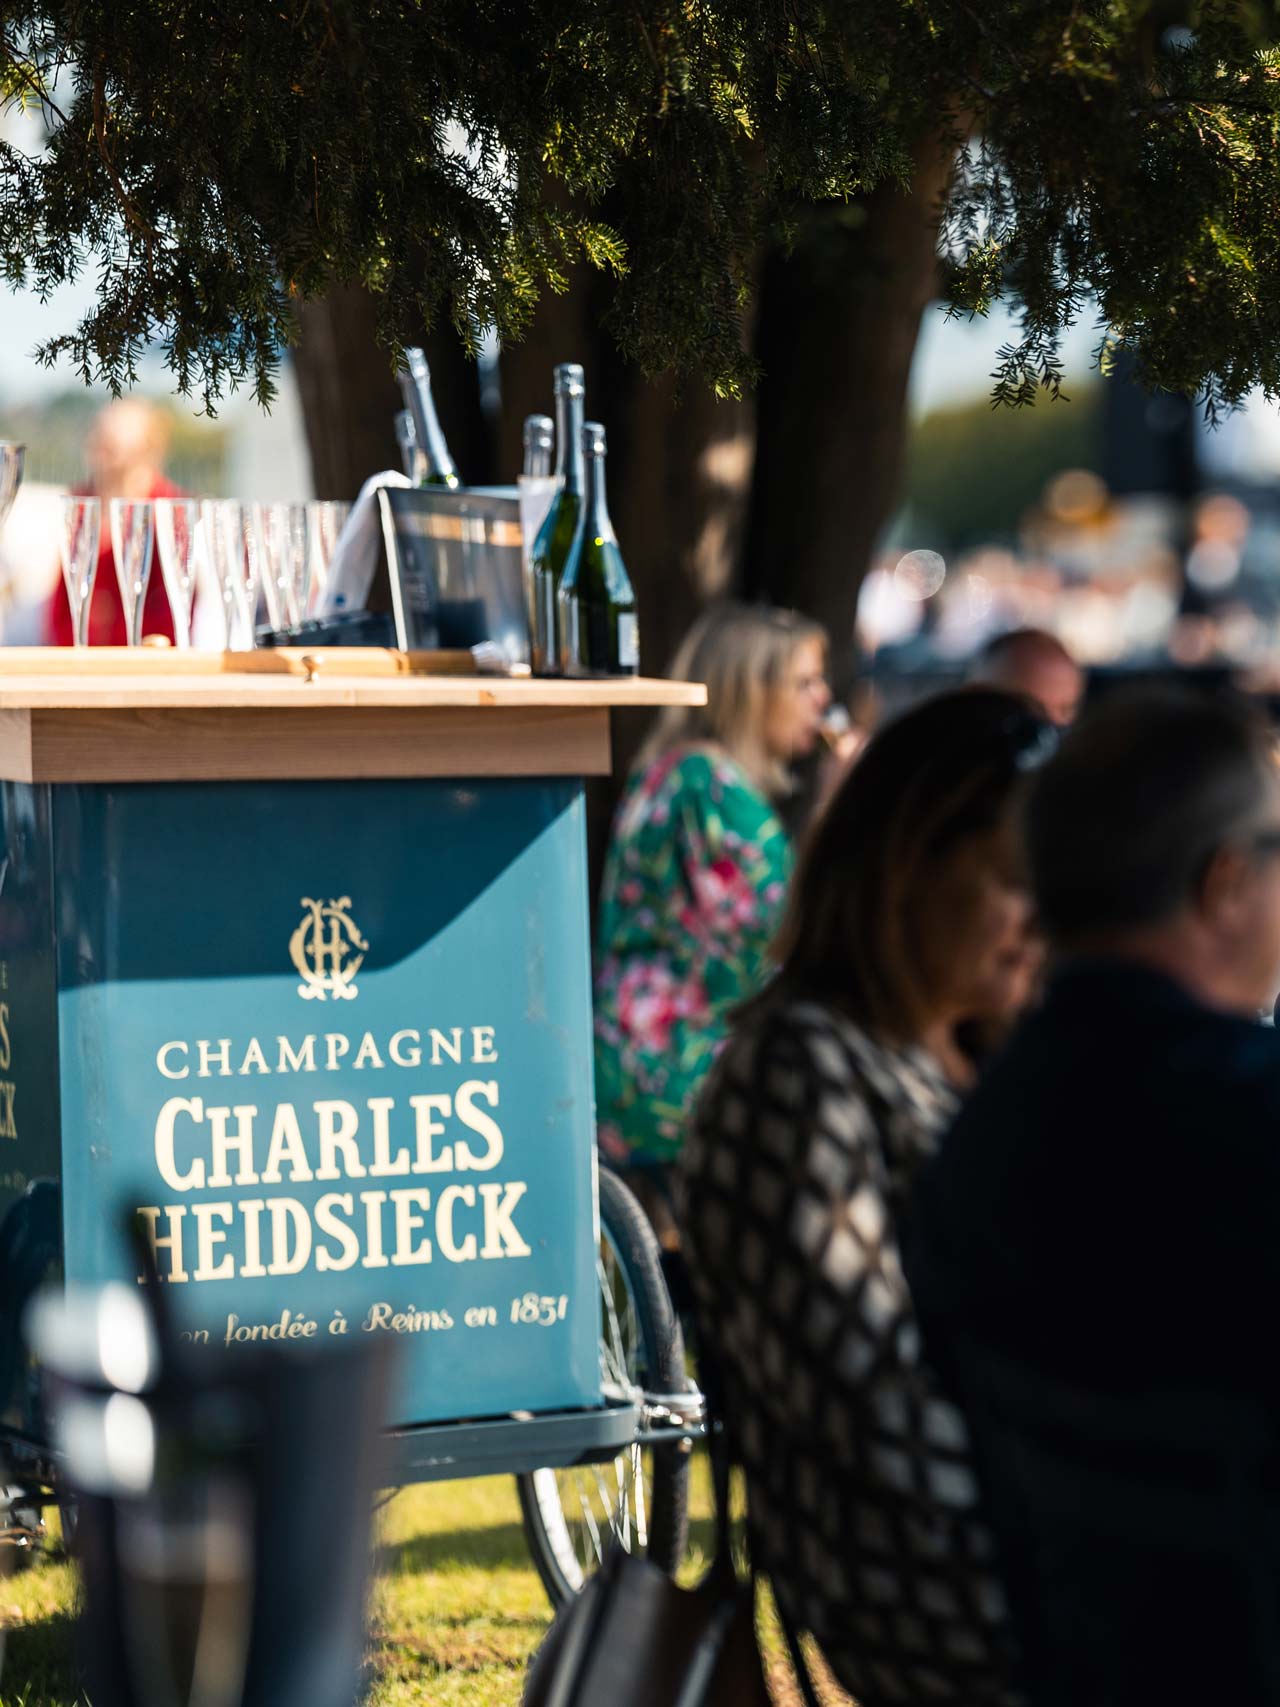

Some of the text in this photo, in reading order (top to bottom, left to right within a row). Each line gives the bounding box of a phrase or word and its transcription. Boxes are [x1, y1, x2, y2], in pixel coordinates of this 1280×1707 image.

[156, 1025, 499, 1080] CHAMPAGNE
[154, 1080, 503, 1191] CHARLES
[137, 1181, 531, 1284] HEIDSIECK
[224, 1308, 318, 1349] fondée
[329, 1309, 349, 1336] à
[362, 1301, 455, 1335] Reims
[464, 1306, 499, 1328] en
[510, 1292, 568, 1327] 1851
